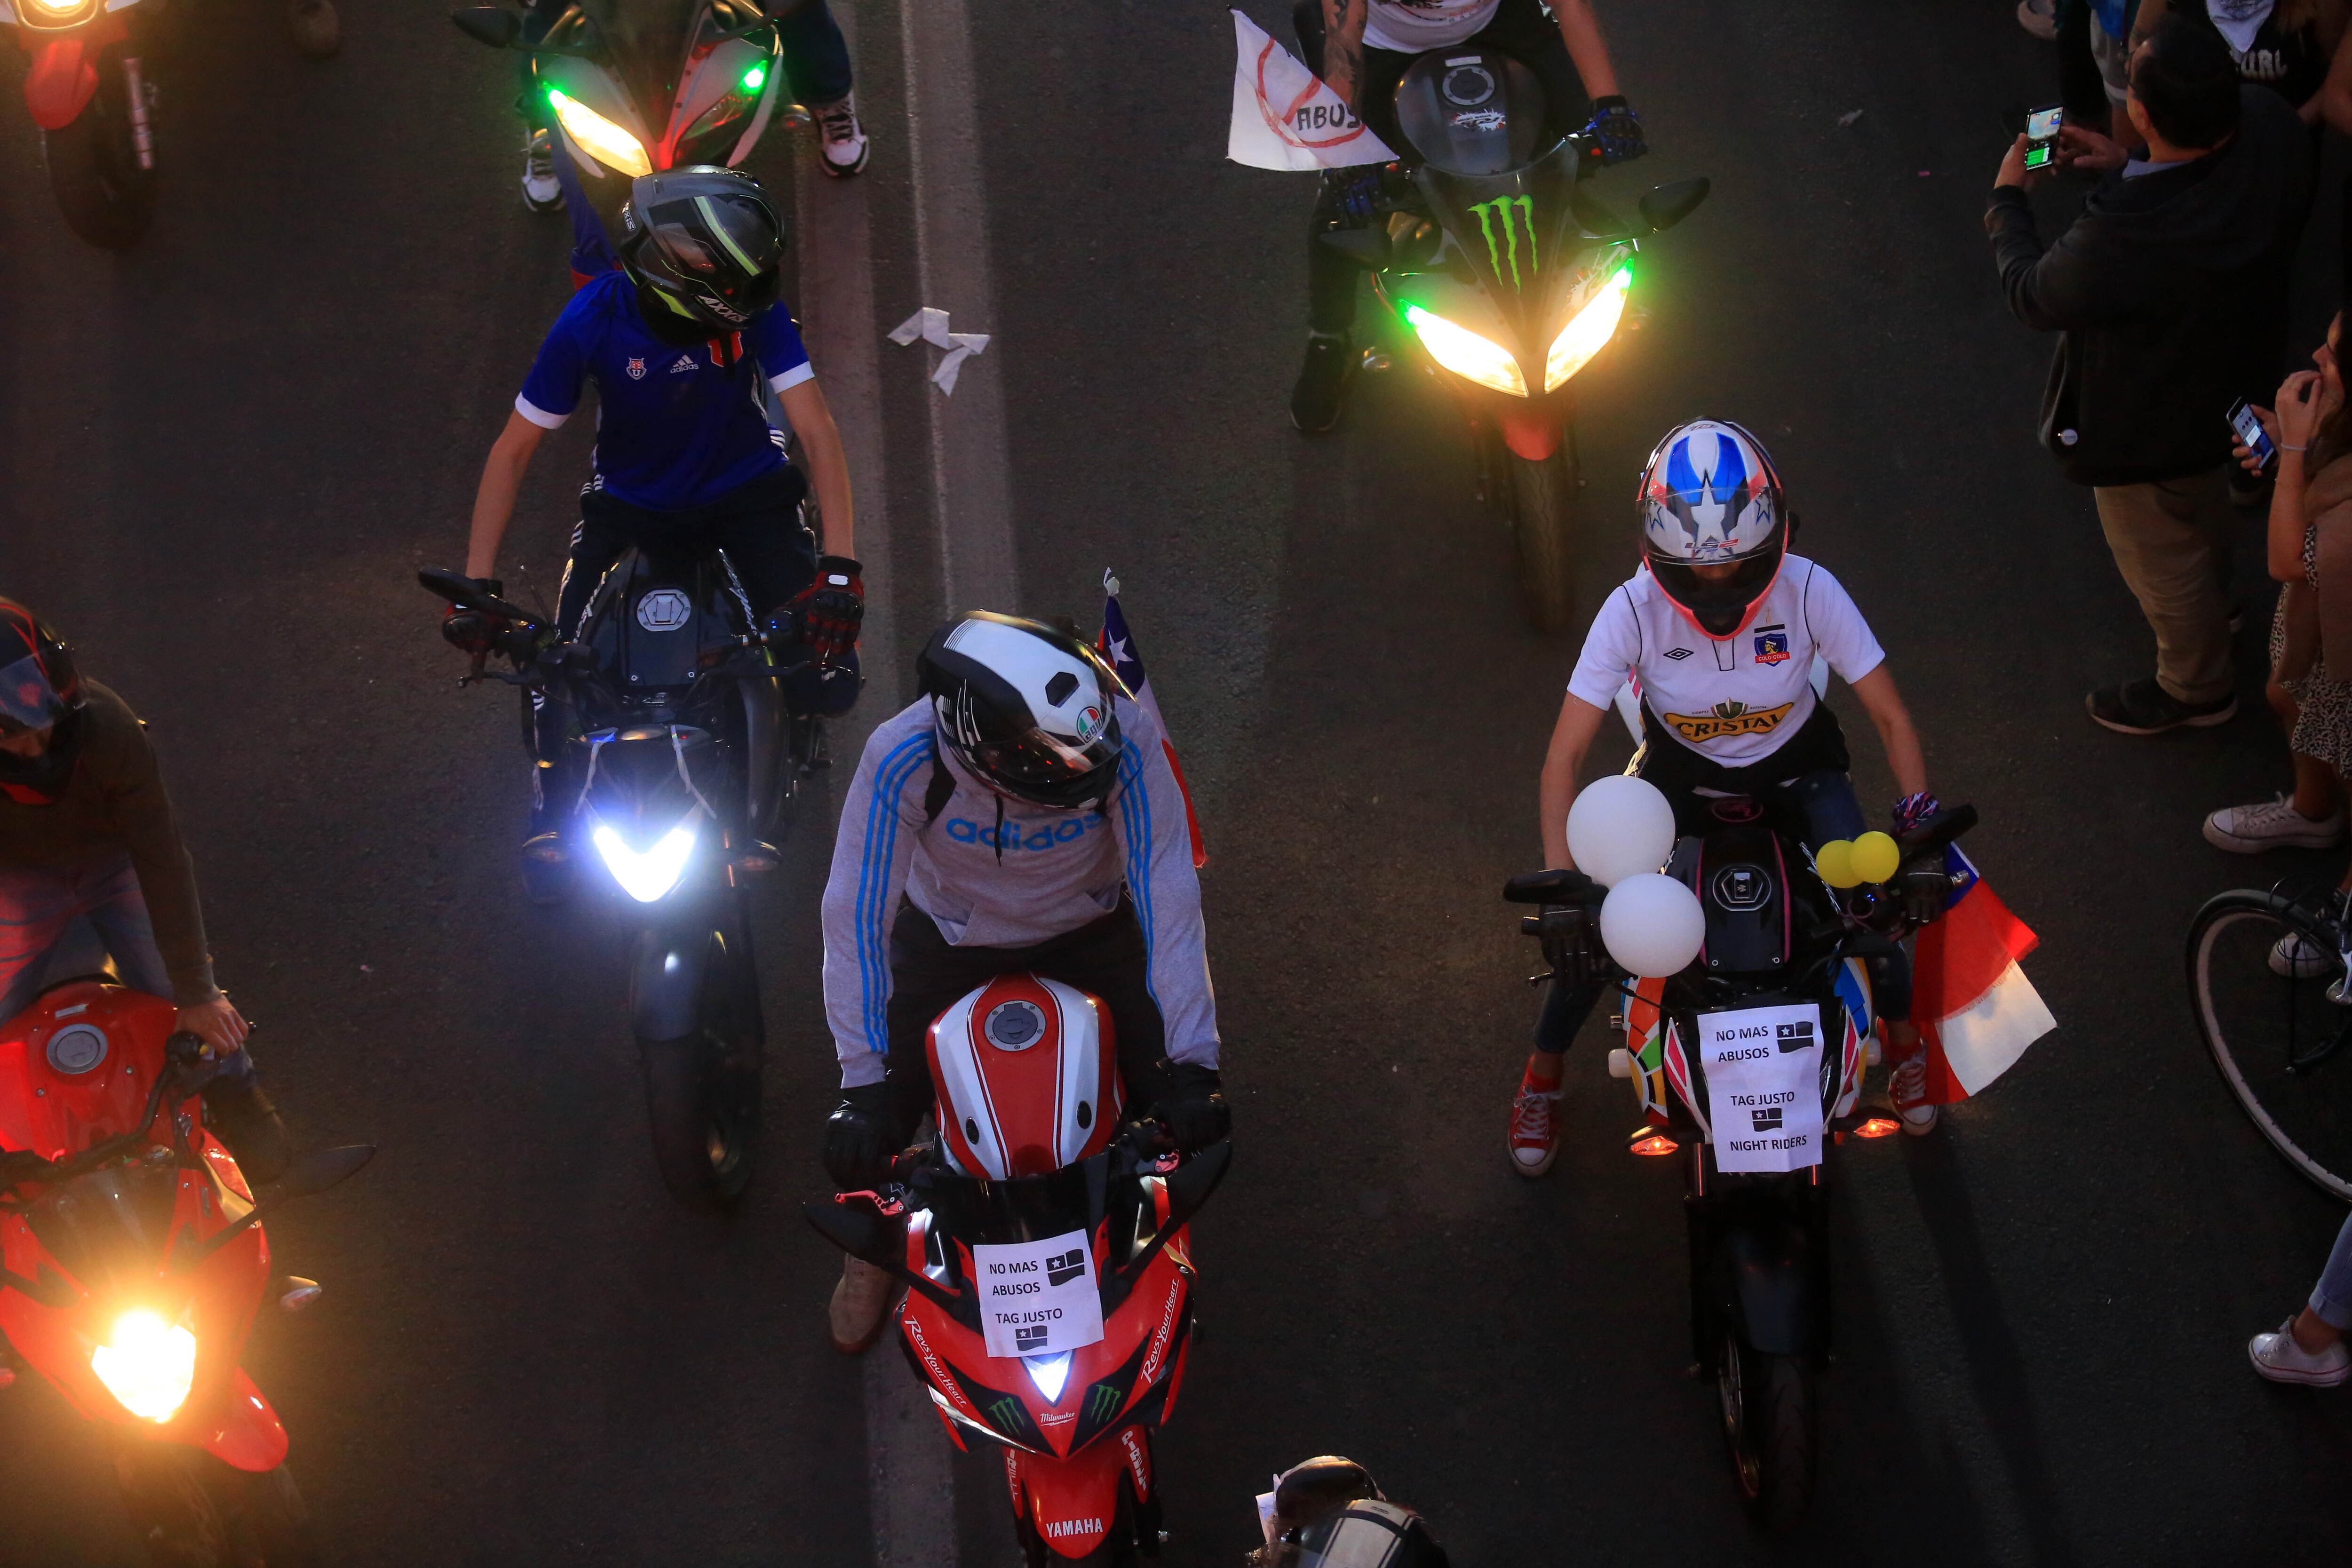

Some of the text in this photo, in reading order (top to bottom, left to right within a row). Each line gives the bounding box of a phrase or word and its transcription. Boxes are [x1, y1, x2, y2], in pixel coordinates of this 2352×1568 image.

[670, 364, 699, 373] adidas
[1685, 539, 1739, 549] LS2
[1676, 714, 1780, 737] CRISTAL
[946, 810, 1102, 851] adidas
[1716, 1026, 1769, 1042] NO MAS
[1718, 1047, 1770, 1062] ABUSOS
[1730, 1091, 1795, 1106] TAG JUSTO
[1730, 1135, 1807, 1151] NIGHT RIDERS
[989, 1260, 1039, 1274] NO MAS
[992, 1281, 1041, 1296] ABUSOS
[995, 1307, 1063, 1324] TAG JUSTO
[1040, 1412, 1075, 1423] Milwaukee
[1121, 1431, 1146, 1491] PIRELLI
[1046, 1518, 1103, 1538] YAMAHA
